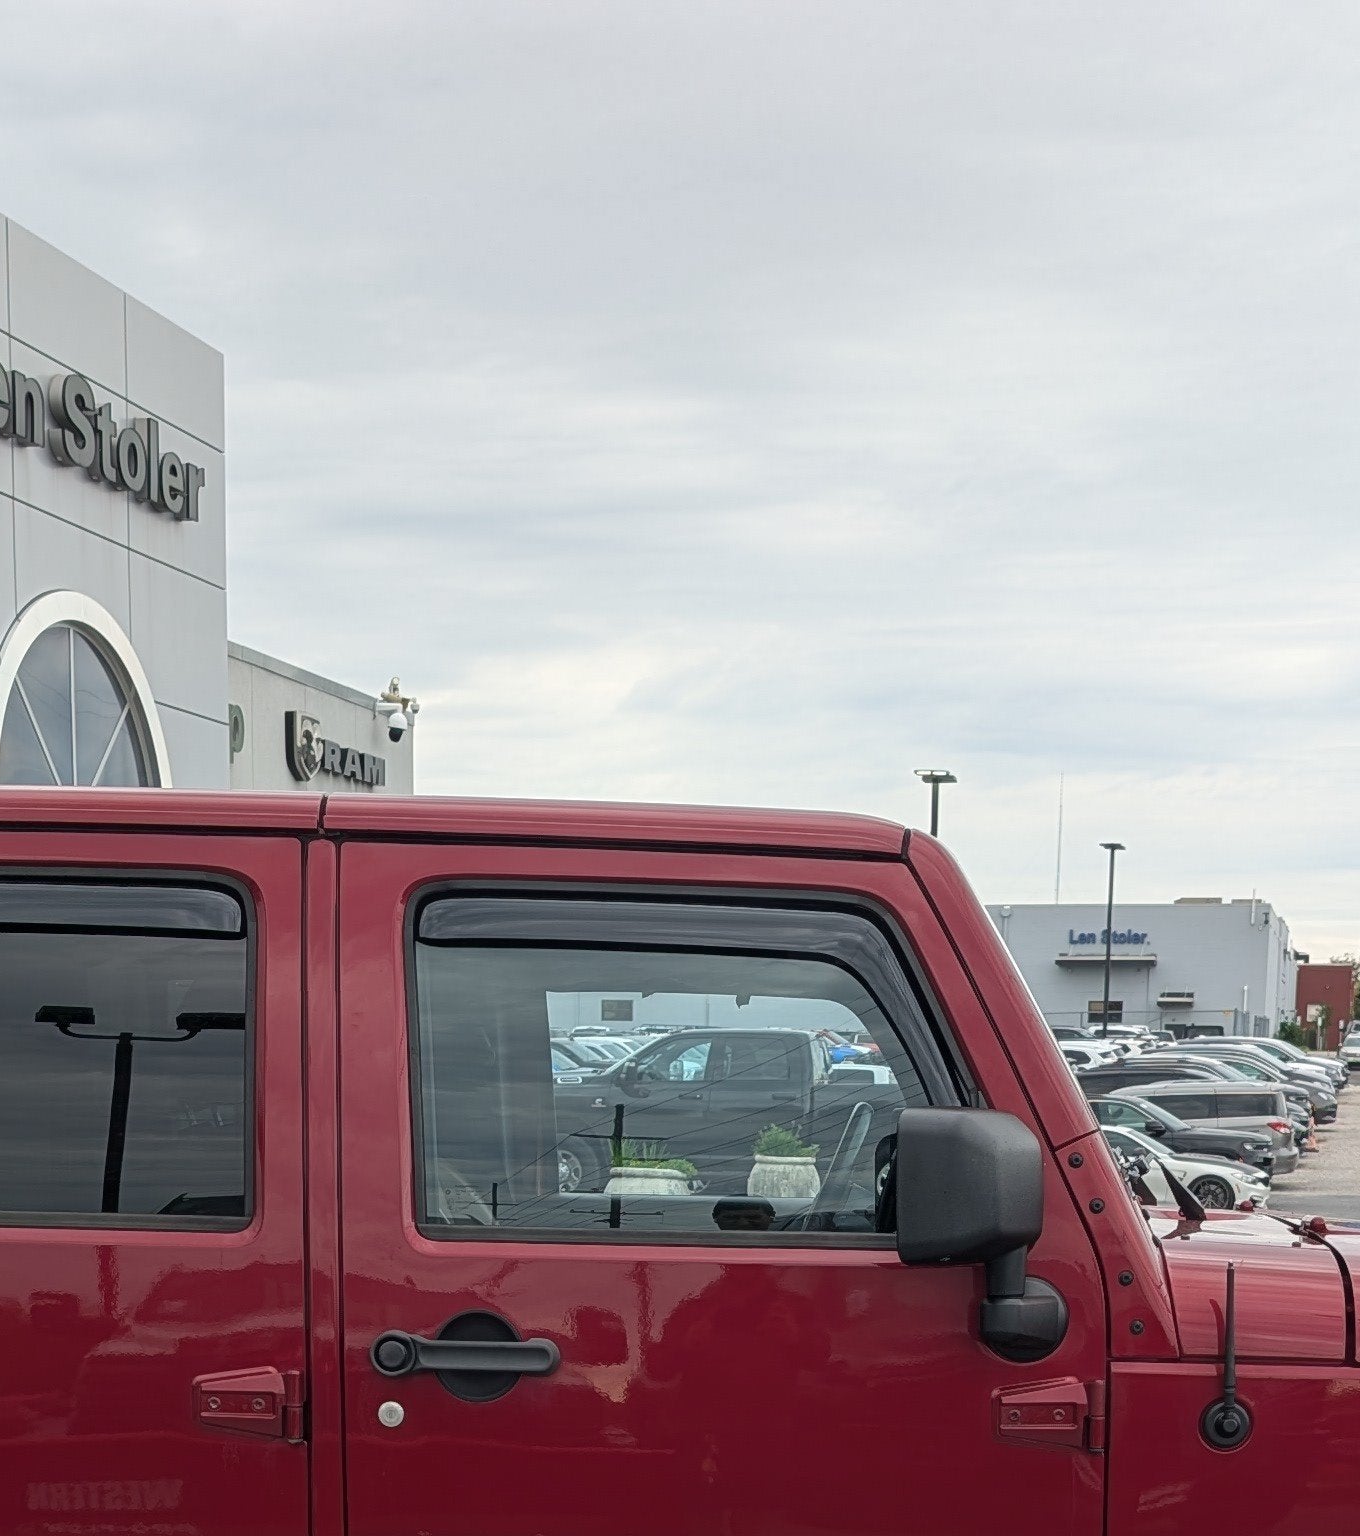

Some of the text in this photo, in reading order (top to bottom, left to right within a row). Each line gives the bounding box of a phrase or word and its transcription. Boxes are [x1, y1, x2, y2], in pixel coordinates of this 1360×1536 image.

[48, 373, 205, 522] Stoler
[321, 738, 386, 786] RAM
[1069, 929, 1096, 944] Len
